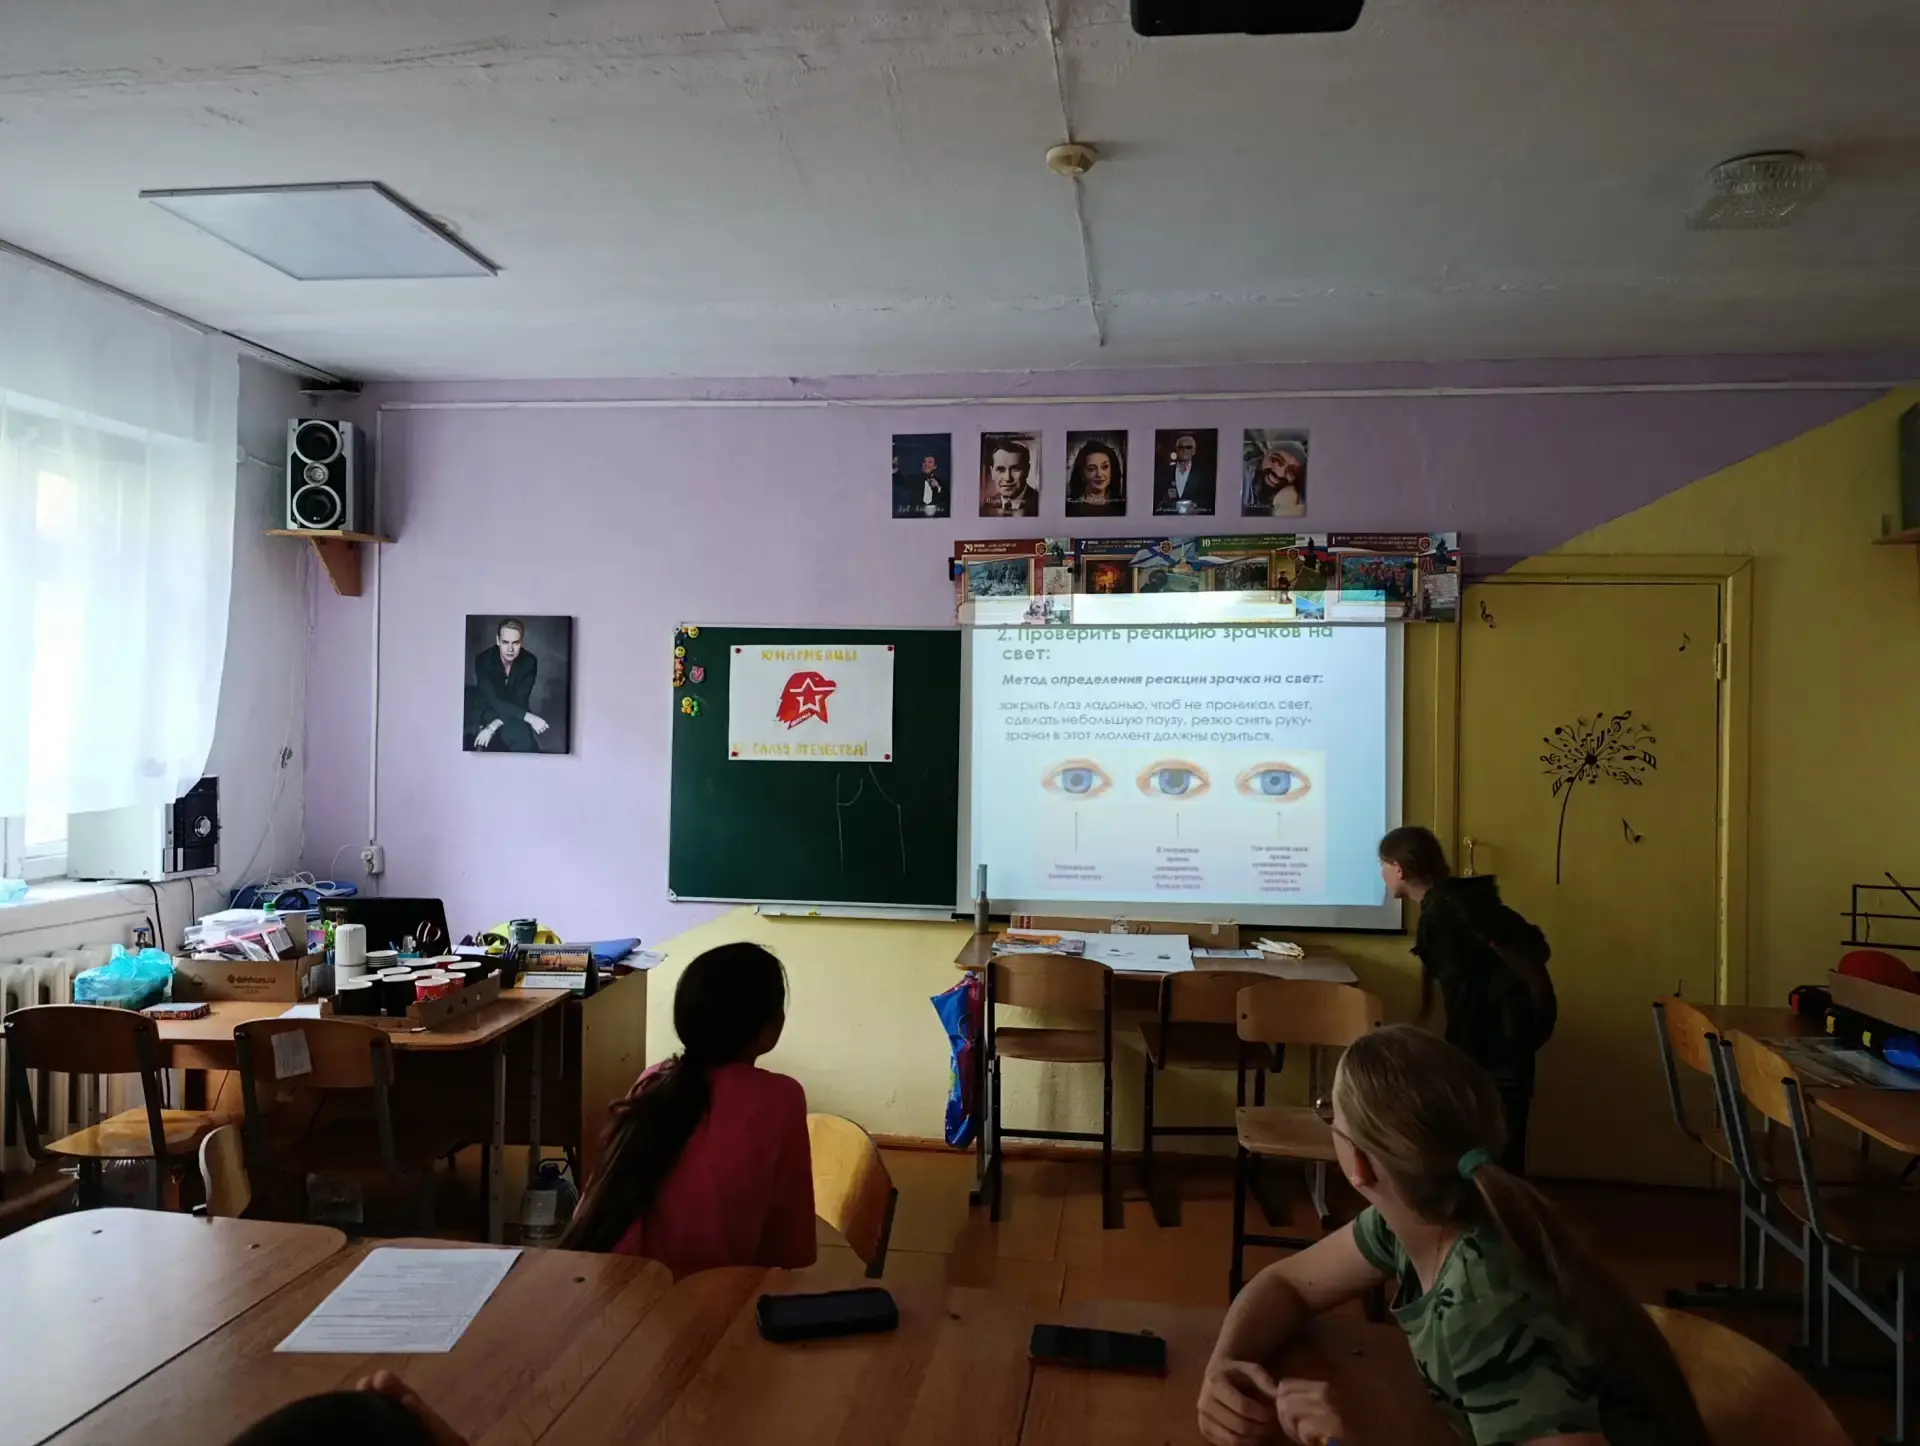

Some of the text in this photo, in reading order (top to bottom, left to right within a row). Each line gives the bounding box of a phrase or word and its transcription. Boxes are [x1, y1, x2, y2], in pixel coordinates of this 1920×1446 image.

[963, 543, 975, 554] 29
[1080, 540, 1087, 550] 7
[997, 626, 1333, 644] 2. Проверить реакцию зрачков на
[1002, 648, 1050, 660] свет:
[1002, 674, 1324, 687] Метод определения реакции зрачка на свет:
[998, 699, 1313, 712] закрыть глаз ладонью, чтоб не проникал свет,
[1005, 716, 1059, 726] сделать
[1062, 714, 1143, 727] небольшую
[1146, 716, 1187, 727] паузу,
[1192, 716, 1232, 727] резко
[1235, 715, 1272, 725] снять
[1005, 731, 1274, 743] зрачки в этот момент должны сузиться.
